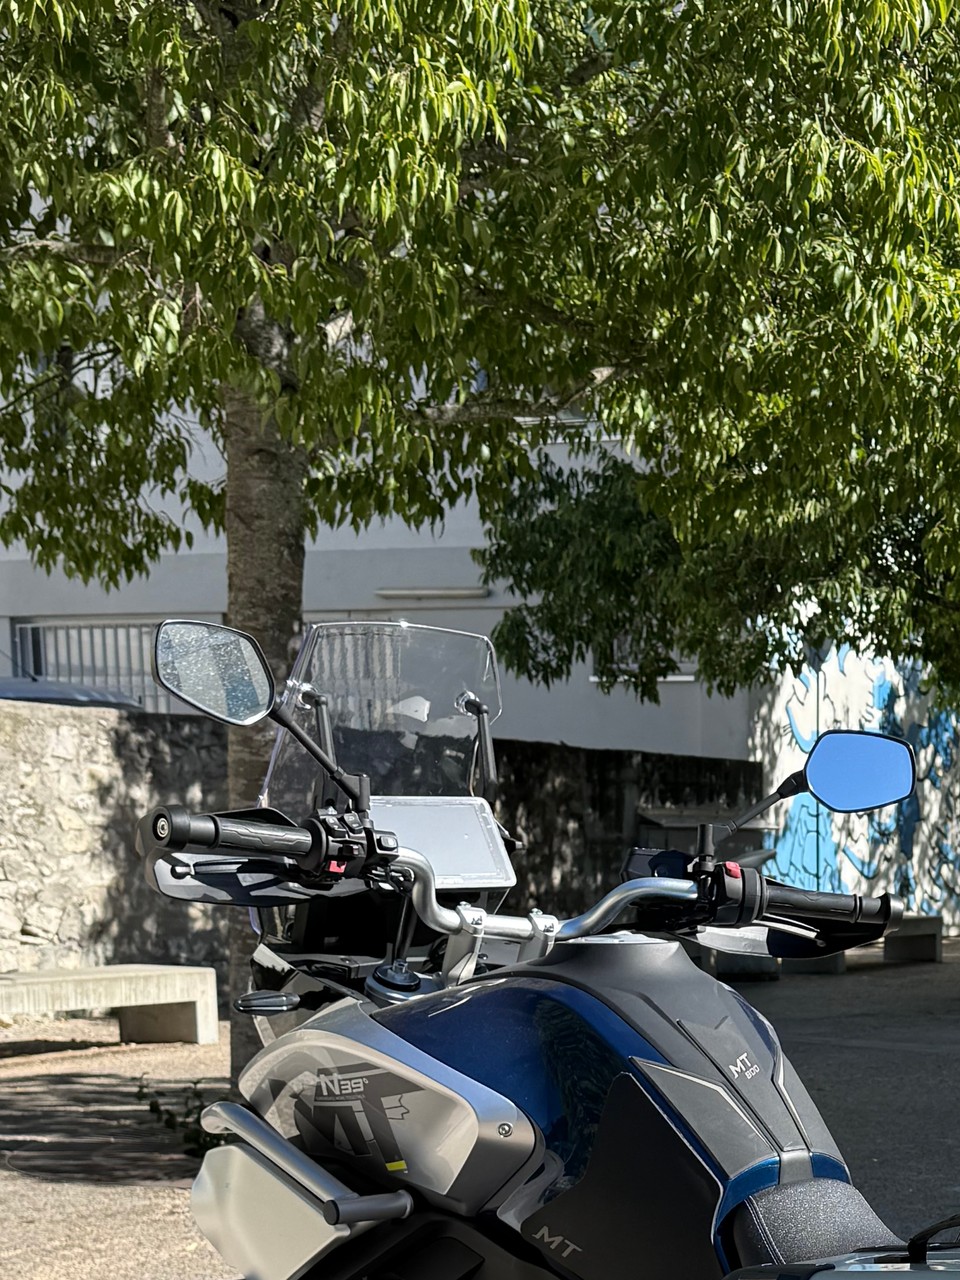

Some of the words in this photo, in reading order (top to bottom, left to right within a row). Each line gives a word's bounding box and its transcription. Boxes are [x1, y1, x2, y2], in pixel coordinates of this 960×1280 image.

[728, 1052, 752, 1079] MT
[744, 1064, 760, 1080] 800
[531, 1225, 583, 1258] MT
